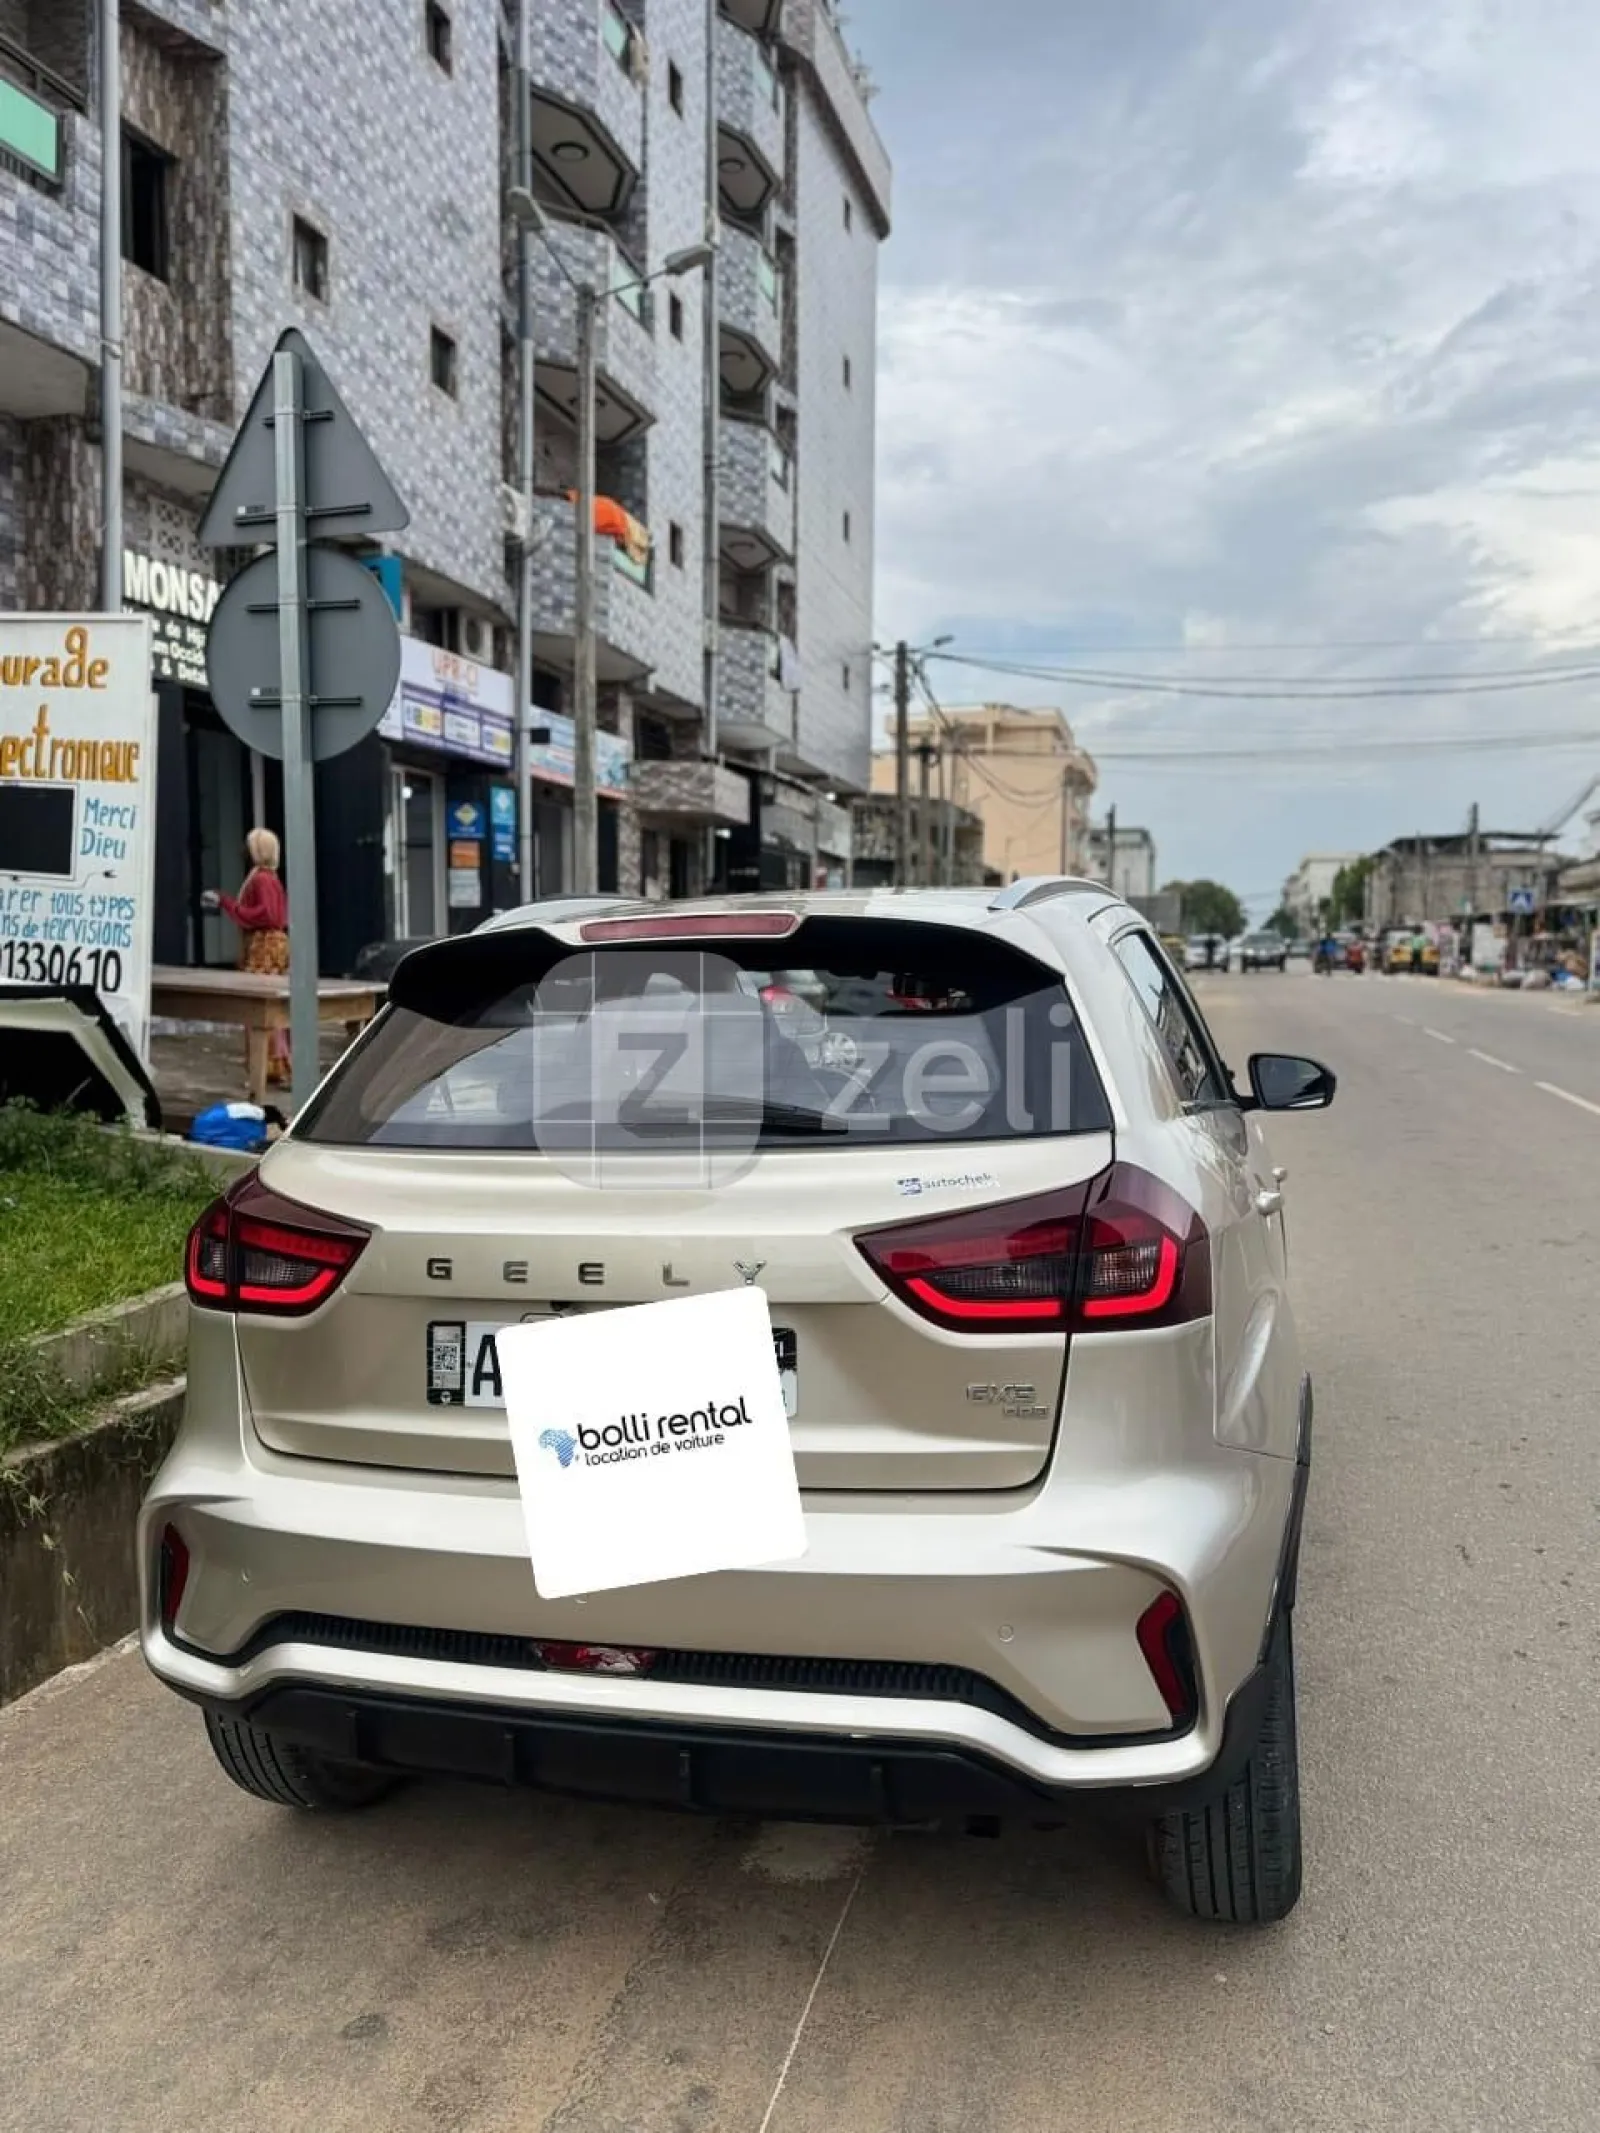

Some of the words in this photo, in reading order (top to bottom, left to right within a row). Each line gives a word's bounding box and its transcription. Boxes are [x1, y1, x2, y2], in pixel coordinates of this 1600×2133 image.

[123, 549, 225, 623] MONSA
[84, 797, 137, 830] Merci
[80, 827, 126, 860] Dieu
[0, 939, 122, 993] 1330610
[426, 1257, 767, 1287] GEELY
[471, 1333, 503, 1397] A
